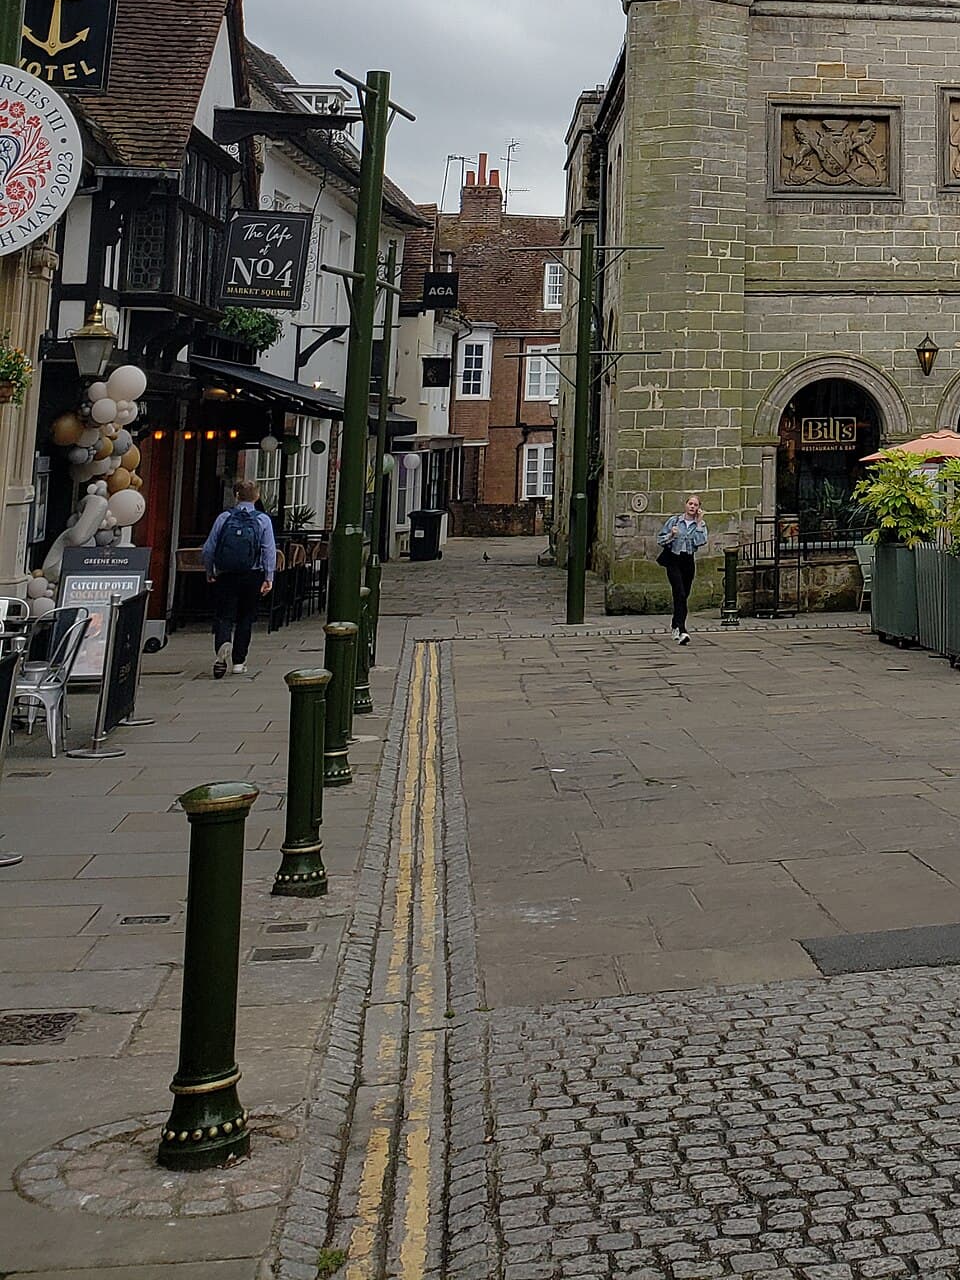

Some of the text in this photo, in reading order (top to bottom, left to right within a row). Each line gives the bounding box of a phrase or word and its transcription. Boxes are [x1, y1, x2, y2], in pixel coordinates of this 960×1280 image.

[0, 73, 68, 134] RLES III
[17, 151, 74, 238] MAY 2023
[242, 223, 267, 241] The
[259, 243, 272, 256] at
[226, 287, 291, 298] MARKET SQUARE
[428, 286, 454, 296] AGA
[71, 581, 134, 590] CATCH UP OVER
